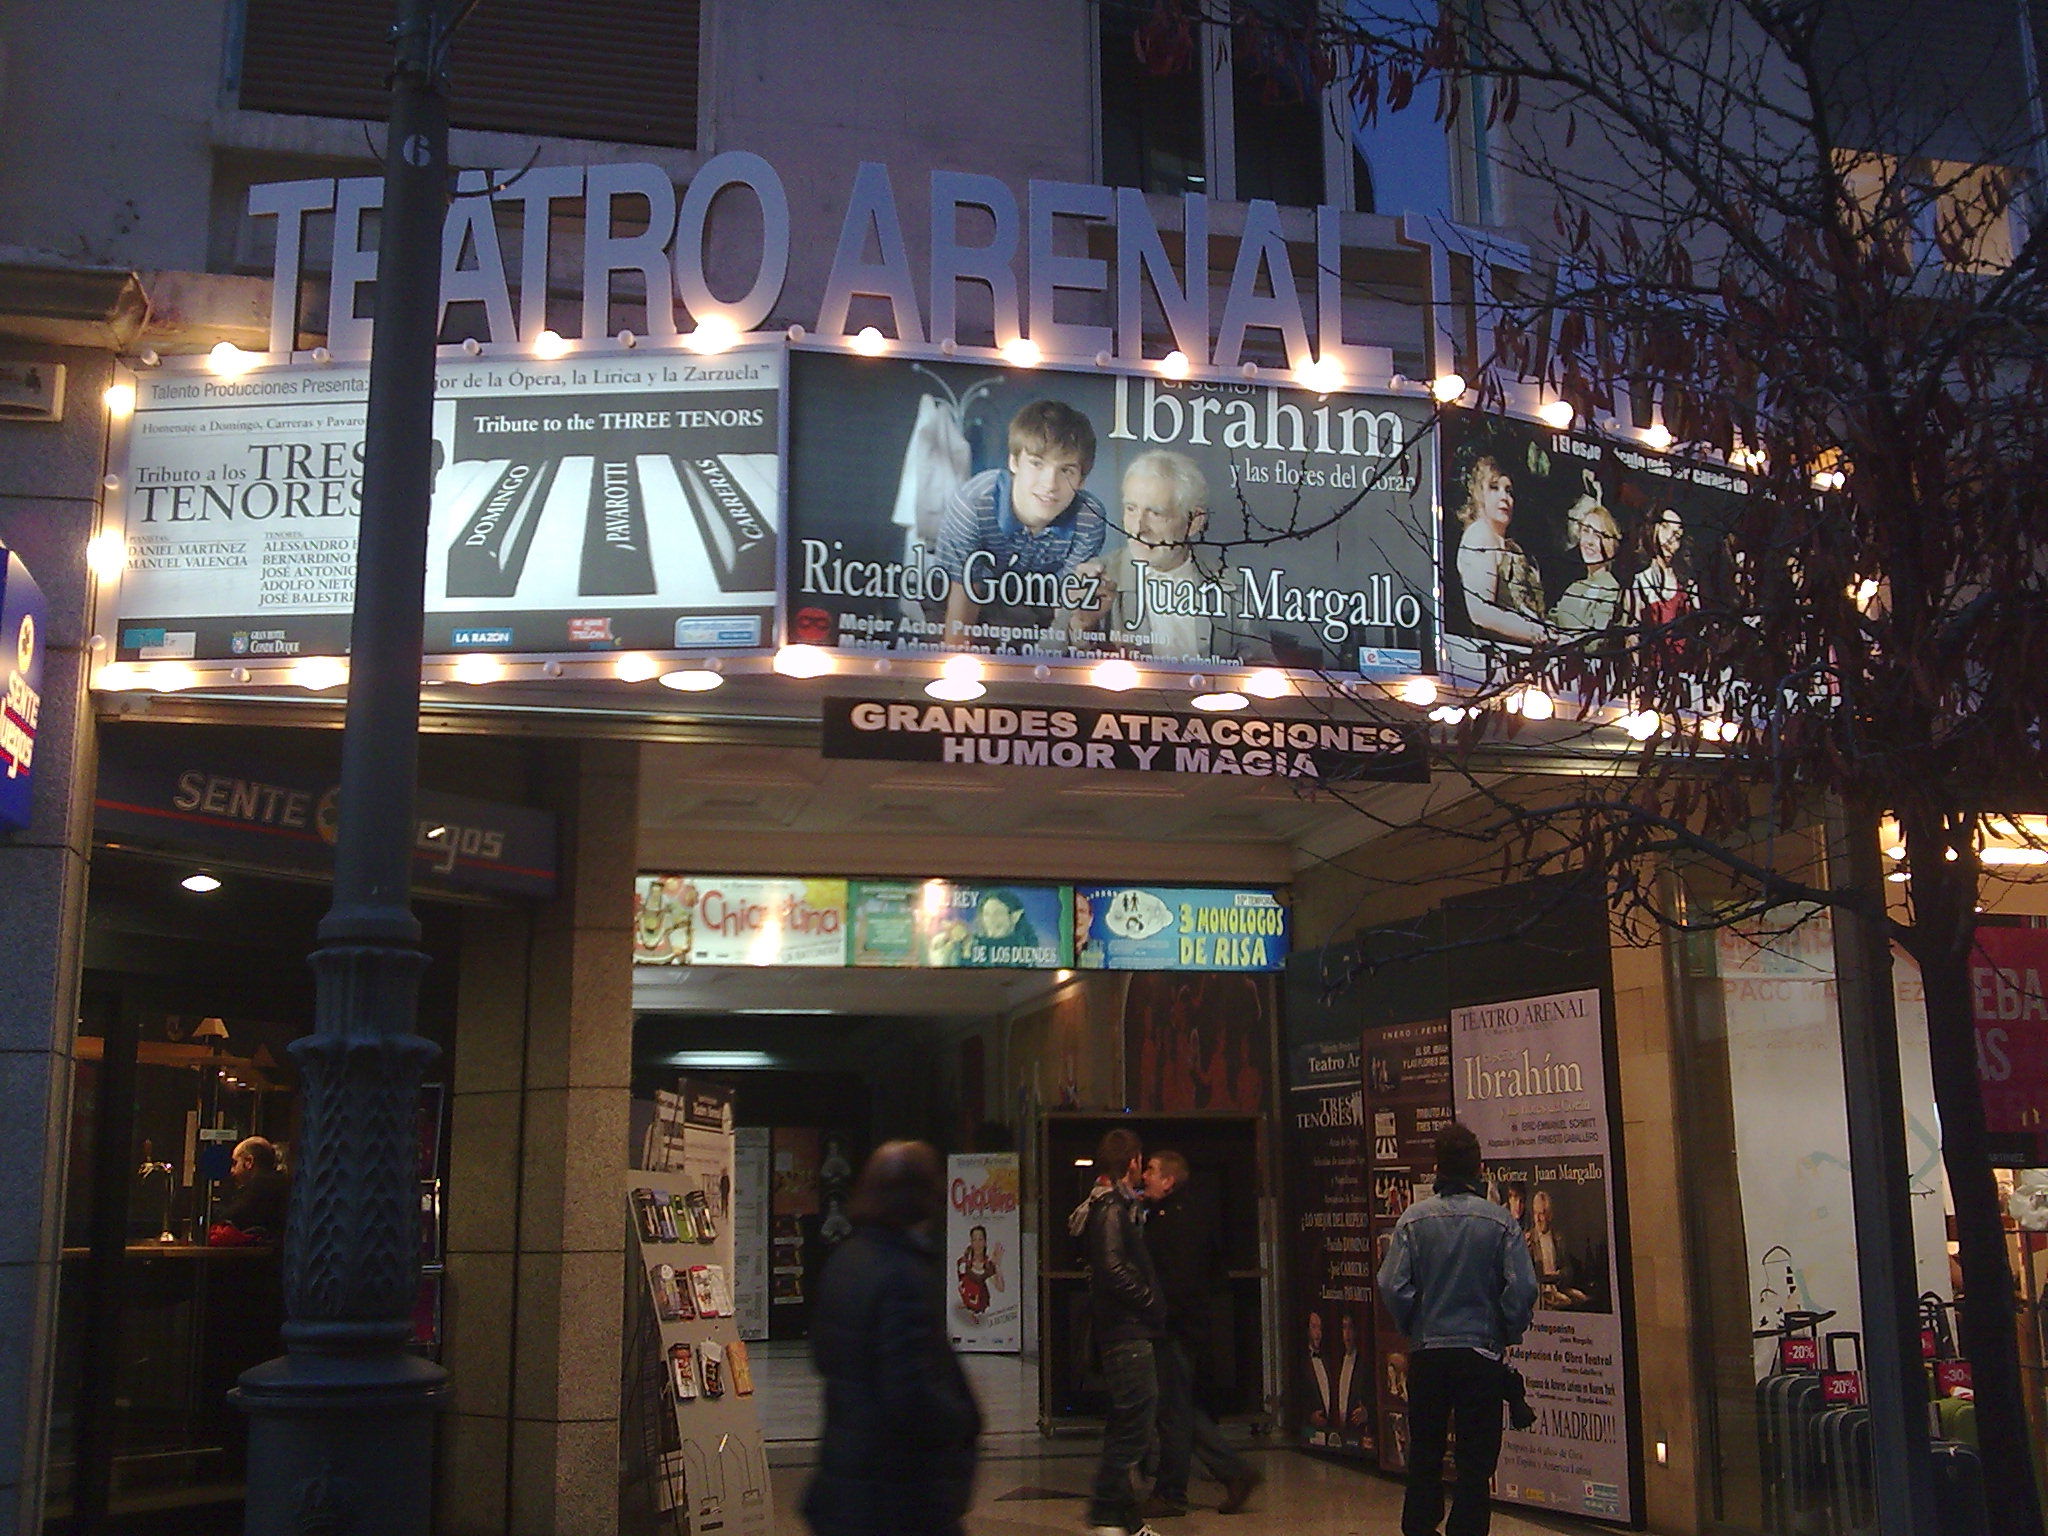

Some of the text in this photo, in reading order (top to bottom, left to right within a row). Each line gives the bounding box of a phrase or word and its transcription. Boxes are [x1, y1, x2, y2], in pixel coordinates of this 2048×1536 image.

[403, 135, 432, 167] 6
[249, 151, 790, 353] TEATRO
[817, 162, 1393, 378] ARENAL
[151, 384, 200, 400] Talento
[204, 380, 298, 397] Producciones
[302, 377, 368, 394] Presenta:
[463, 373, 482, 388] de
[488, 371, 502, 387] la
[573, 369, 587, 385] la
[647, 371, 655, 386] y
[662, 366, 677, 382] la
[142, 423, 196, 435] Homenaje
[200, 423, 206, 431] a
[266, 418, 314, 429] Carreras
[317, 418, 322, 429] y
[326, 416, 366, 427] Pavaro
[474, 408, 765, 433] Tribute to the THREE TENORS
[136, 466, 200, 484] Tributo
[206, 470, 217, 481] a
[221, 464, 247, 481] los
[1229, 463, 1239, 489] y
[1245, 458, 1269, 483] las
[1274, 460, 1325, 488] flores
[1330, 463, 1357, 489] del
[465, 464, 530, 547] DOMINGO
[603, 461, 630, 543] PAVAROTTI
[695, 458, 765, 540] CARRERAS
[128, 545, 173, 556] DANIEL
[262, 553, 351, 565] BERNARDINO
[263, 540, 349, 552] ALESSANDRO
[127, 556, 248, 569] MANUEL VALENCIA
[801, 538, 1102, 610] Ricardo Gómez
[260, 579, 315, 591] ADOLFO
[1124, 560, 1421, 644] Juan Margallo
[455, 633, 470, 643] LA
[839, 612, 894, 634] Mejor
[899, 616, 946, 635] Actor
[951, 620, 1068, 642] Protagonista
[850, 703, 1406, 756] GRANDES ATRACCIONES
[943, 736, 1320, 778] HUMOR Y MAGIA
[173, 769, 313, 828] SENTE
[953, 890, 980, 908] REY
[1179, 903, 1285, 937] 3 MONOLOGOS
[1179, 937, 1209, 965] DE
[1214, 936, 1268, 966] RISA
[1460, 998, 1590, 1032] TEATRO ARENAL
[1308, 1052, 1361, 1073] Teatro Ar
[1319, 1096, 1352, 1114] TRES
[1296, 1111, 1352, 1129] TENORES
[1533, 1164, 1557, 1186] Juan
[1558, 1162, 1603, 1185] Margallo
[1584, 1352, 1613, 1366] Teatral
[1788, 1344, 1815, 1359] -20%
[1828, 1379, 1857, 1395] -20%
[1539, 1406, 1617, 1444] A MADRID!!!
